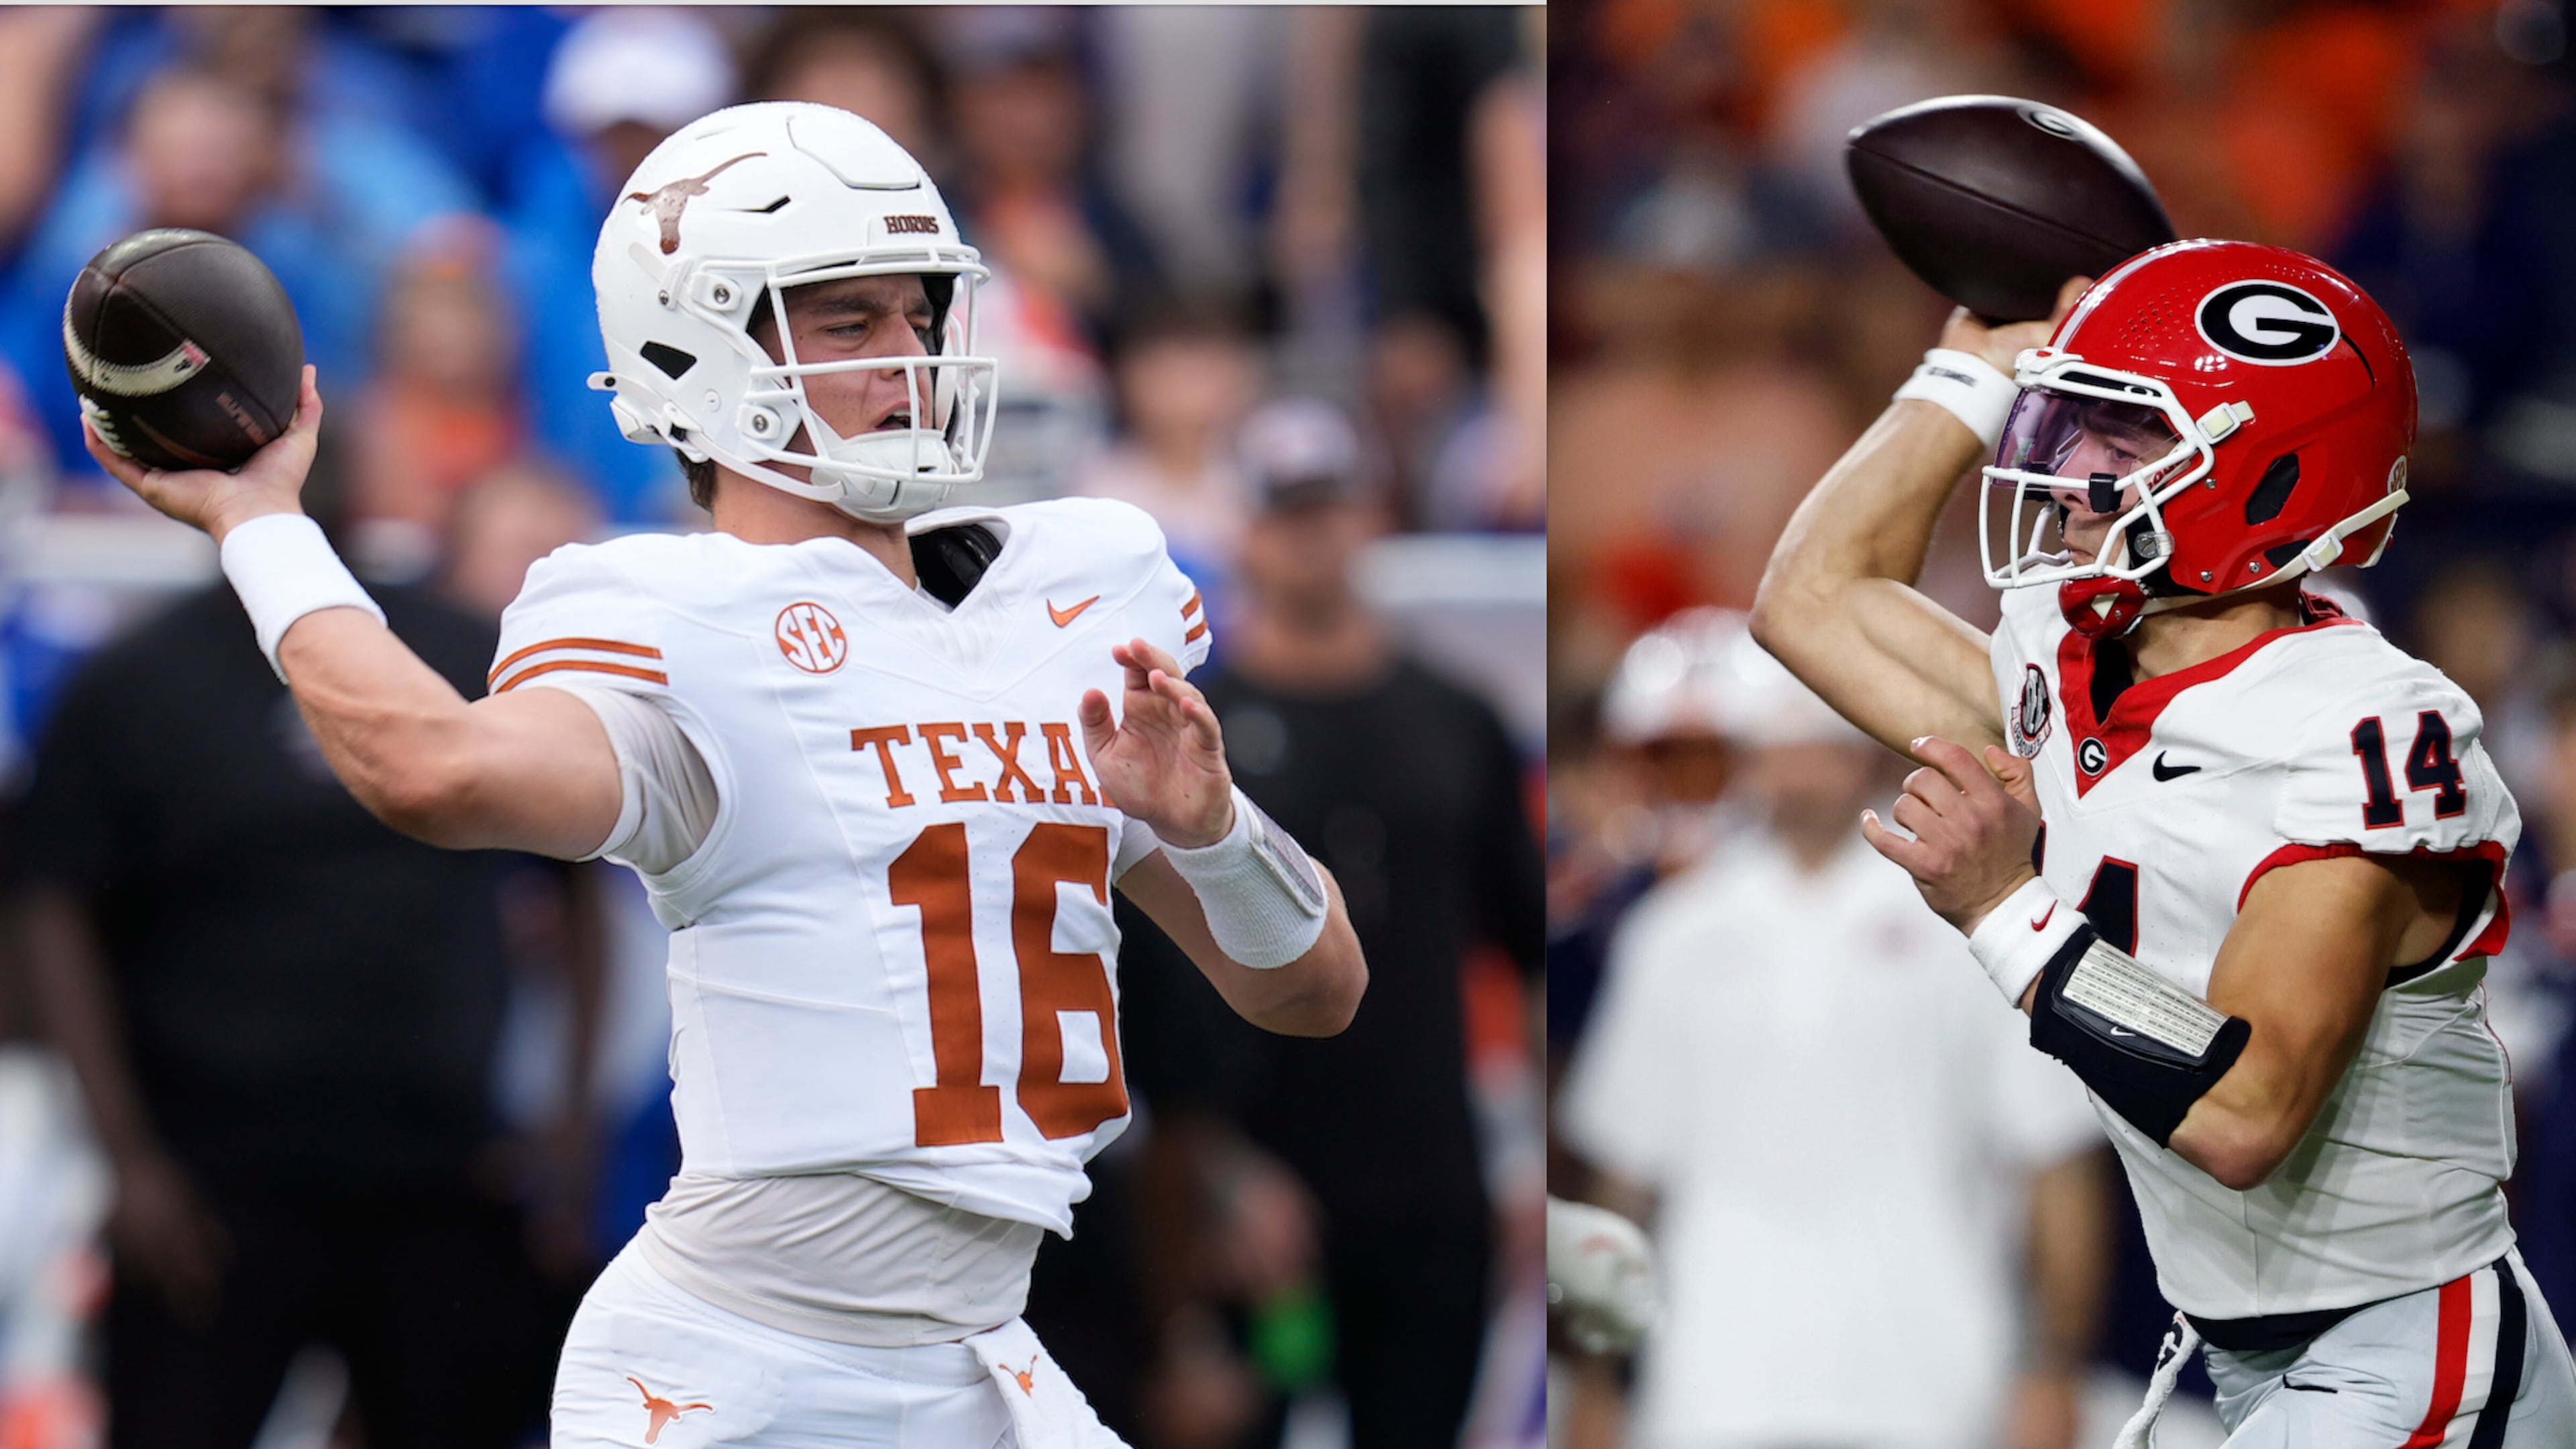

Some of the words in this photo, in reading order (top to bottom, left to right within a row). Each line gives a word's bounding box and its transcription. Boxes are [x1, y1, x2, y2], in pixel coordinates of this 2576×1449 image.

[883, 215, 940, 233] HORNS
[2199, 283, 2337, 361] G
[775, 602, 847, 674] SEC
[851, 721, 1119, 809] TEXA
[2079, 738, 2106, 774] G
[2351, 709, 2467, 830] 14
[888, 821, 1128, 1148] 16
